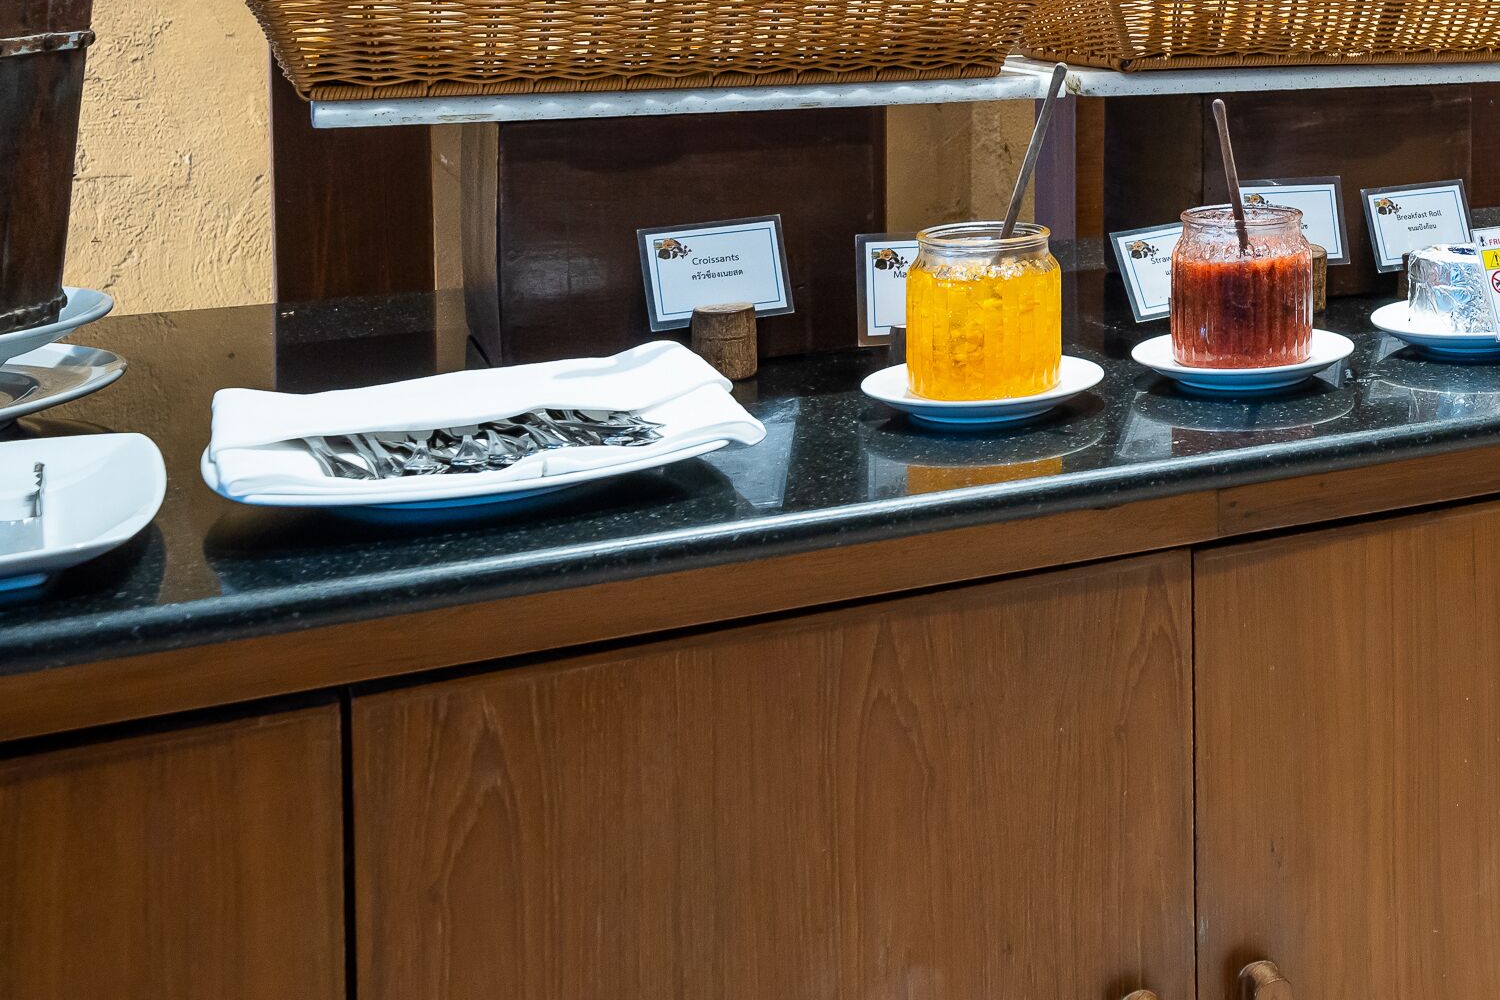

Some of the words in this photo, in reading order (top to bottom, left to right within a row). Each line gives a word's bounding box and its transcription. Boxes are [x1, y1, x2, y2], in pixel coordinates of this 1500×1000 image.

[1397, 212, 1428, 220] Breakfast
[1428, 209, 1442, 217] Roll
[692, 254, 740, 265] Croissants
